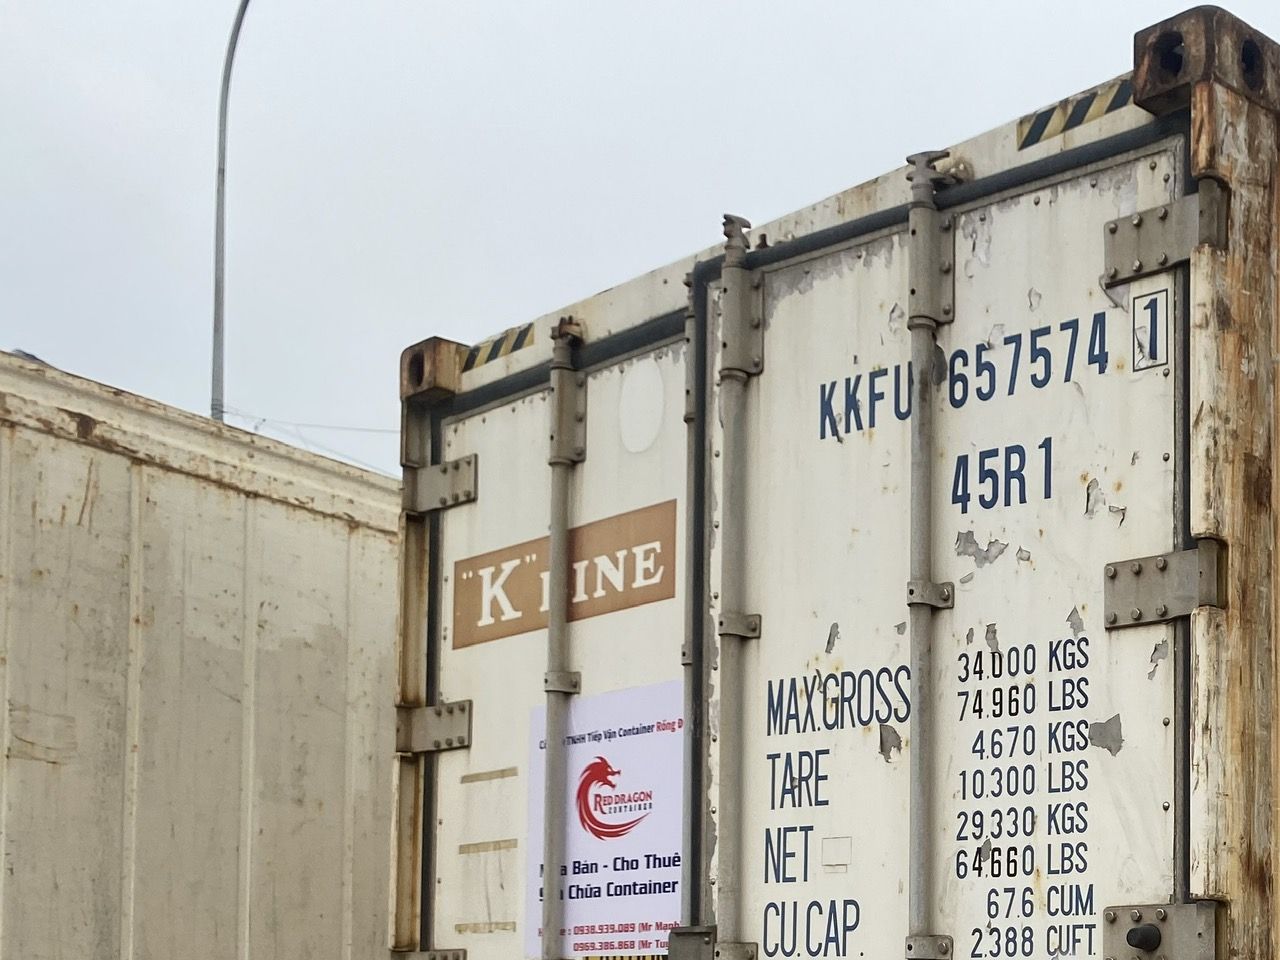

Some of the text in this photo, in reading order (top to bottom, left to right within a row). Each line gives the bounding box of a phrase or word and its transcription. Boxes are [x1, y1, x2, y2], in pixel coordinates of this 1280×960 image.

[819, 360, 913, 441] KKFU
[947, 311, 1109, 409] 657574
[951, 436, 1053, 515] 45R1
[956, 637, 1090, 684] 34.000 KGS
[956, 676, 1090, 722] 74.960 LBS
[617, 723, 655, 738] Container
[971, 719, 1090, 761] 4.670 KGS
[766, 748, 831, 811] TARE
[958, 759, 1090, 801] 10.300 LBS
[955, 801, 1089, 842] 29.330 KGS
[613, 856, 639, 872] Cho
[644, 852, 682, 869] Thuê
[763, 824, 815, 885] NET
[955, 841, 1089, 880] 64.660 LBS
[606, 879, 679, 897] Container
[986, 886, 1035, 920] 67.6
[970, 925, 1036, 959] 2.388
